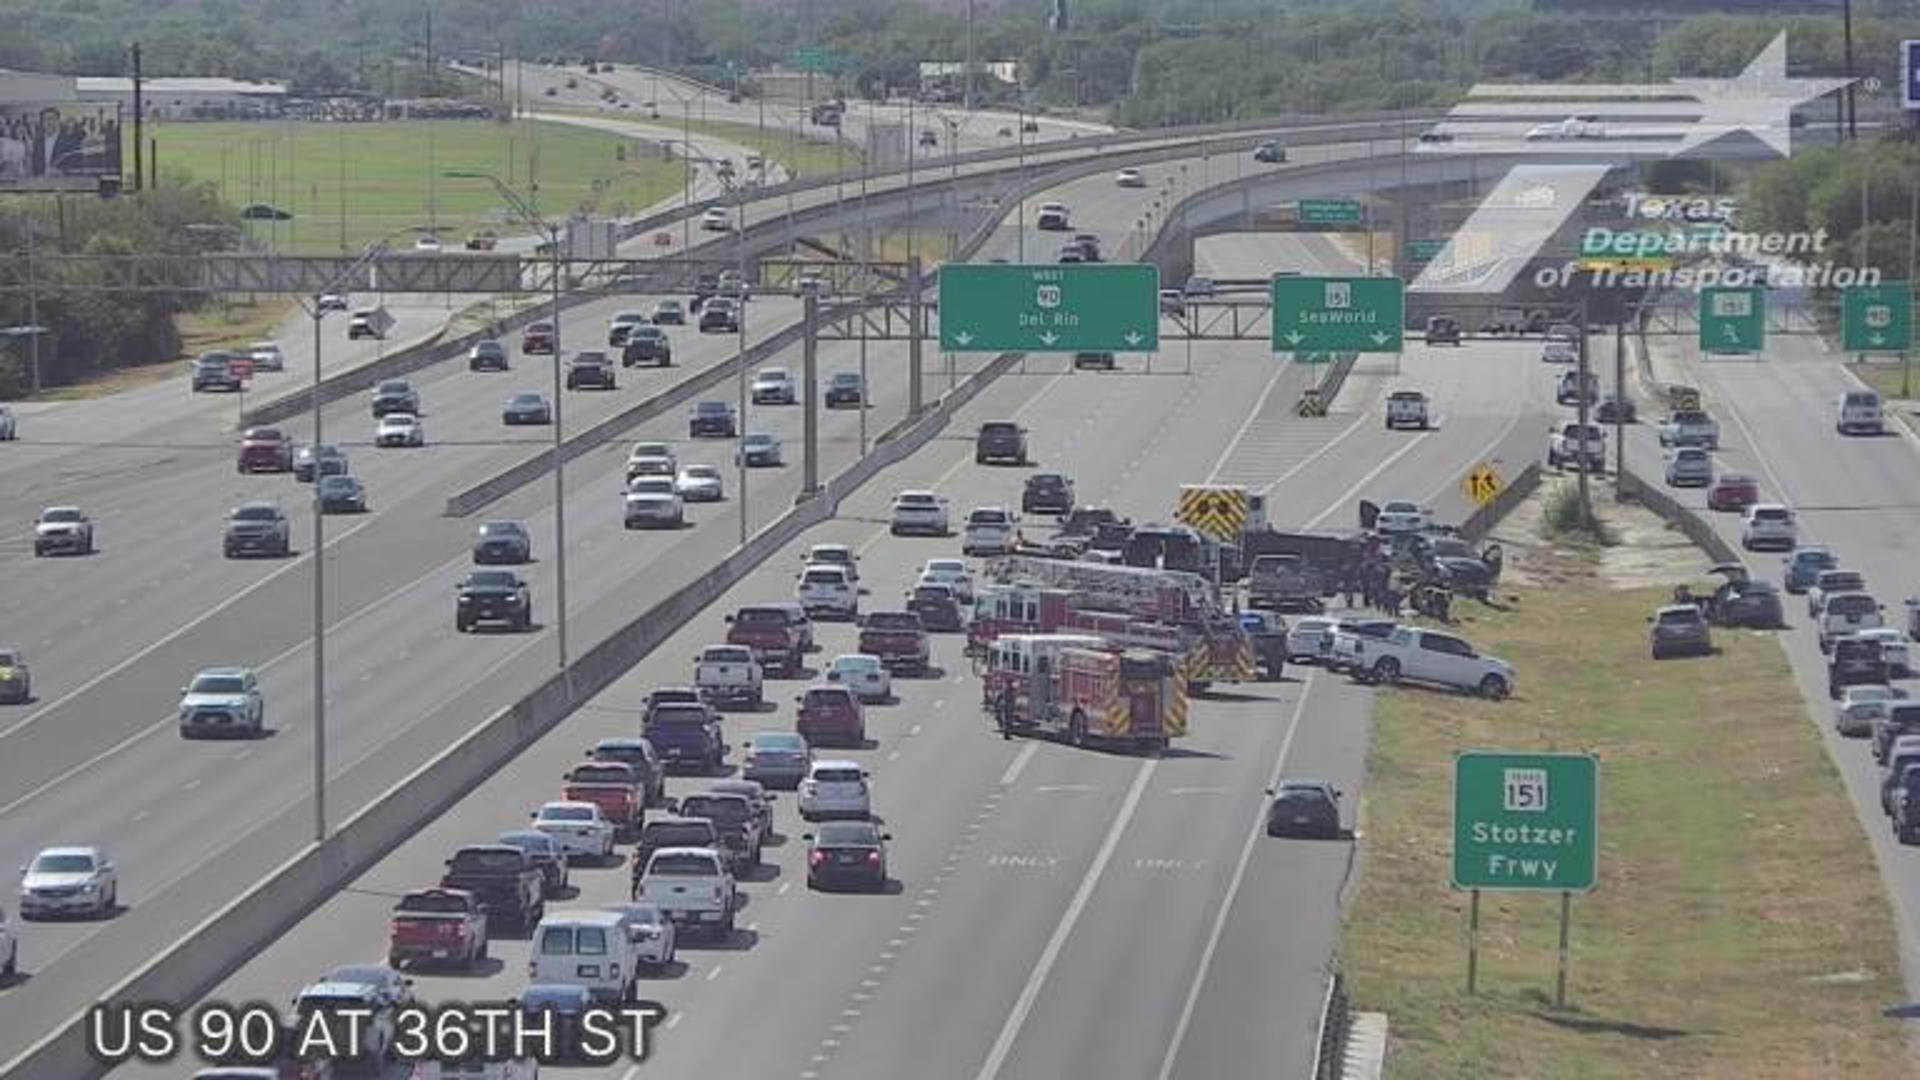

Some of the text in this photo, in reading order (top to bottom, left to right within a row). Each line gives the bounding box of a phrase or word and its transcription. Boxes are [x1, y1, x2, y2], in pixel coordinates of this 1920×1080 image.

[1298, 309, 1377, 324] SeaWorld
[1508, 784, 1545, 808] 151
[1472, 821, 1577, 844] Stotzer
[1487, 854, 1558, 881] Frwy
